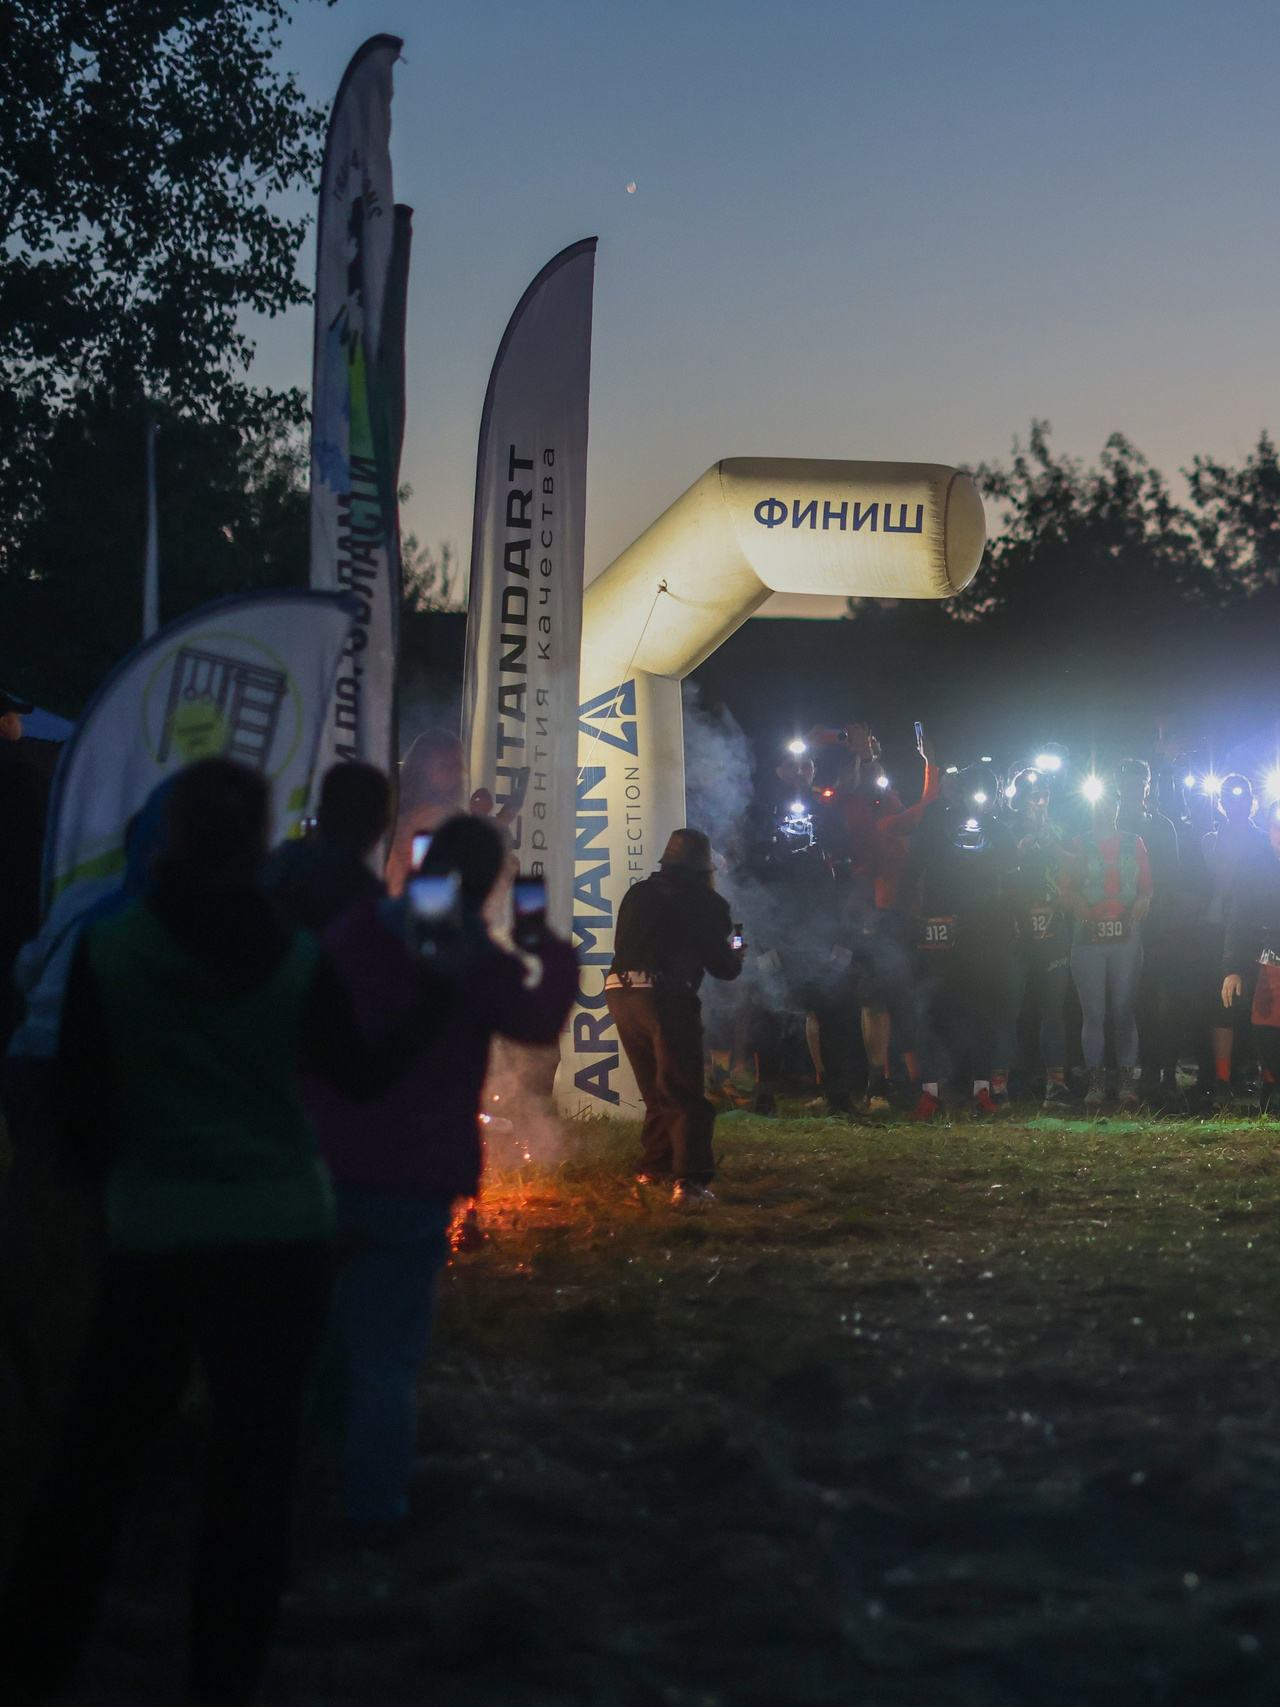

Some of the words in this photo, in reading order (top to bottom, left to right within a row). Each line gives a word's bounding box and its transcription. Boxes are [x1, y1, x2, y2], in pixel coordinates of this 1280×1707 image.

[537, 448, 555, 660] качества
[754, 498, 924, 533] ФИНИШ
[531, 688, 550, 877] арантия
[624, 767, 644, 887] RFECTION
[572, 766, 620, 1106] ARCMANN
[925, 924, 948, 941] 312
[1097, 921, 1123, 937] 330
